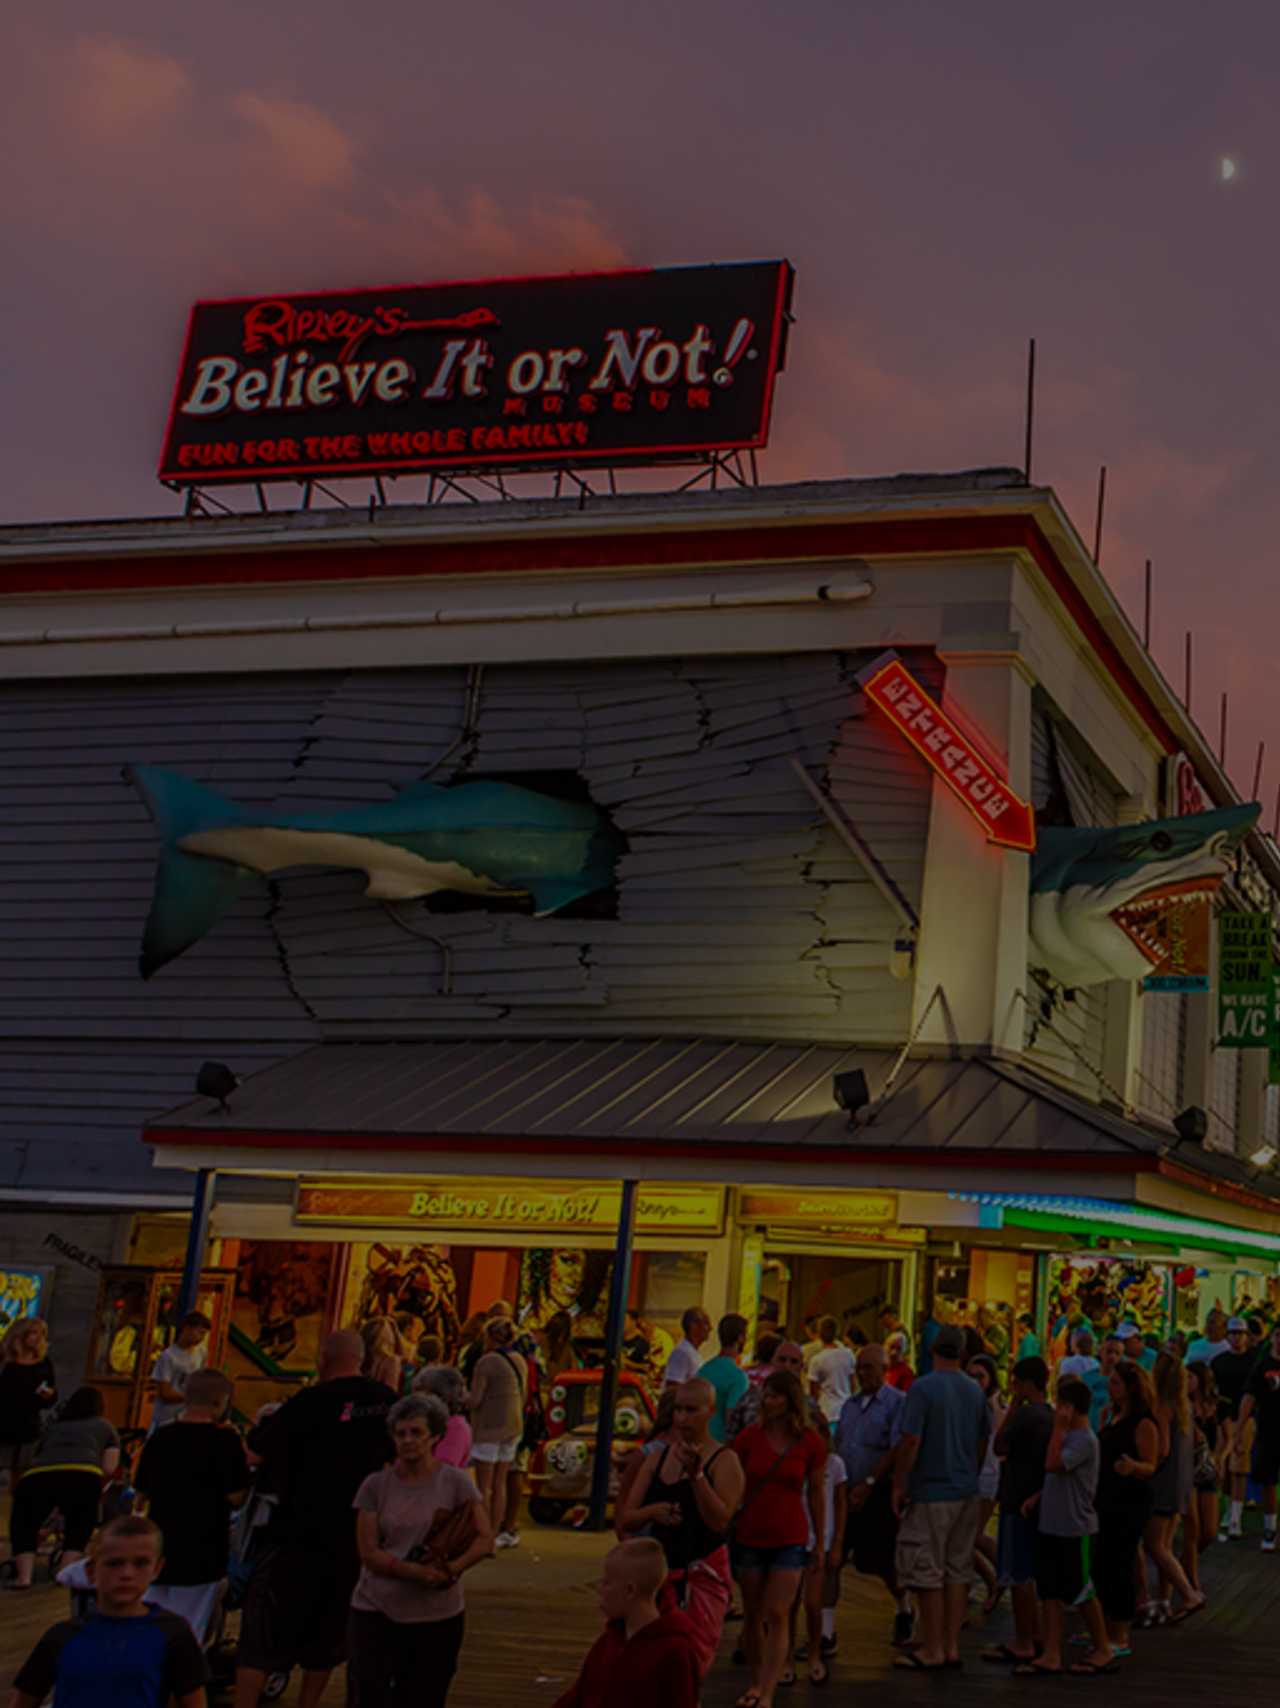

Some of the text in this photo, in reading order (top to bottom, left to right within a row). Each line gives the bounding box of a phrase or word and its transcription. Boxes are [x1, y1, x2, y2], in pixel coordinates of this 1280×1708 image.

[181, 316, 758, 417] Believe It or Not!
[177, 441, 239, 468] FUN
[242, 437, 299, 464] FOR
[301, 432, 361, 460] THE
[367, 427, 468, 457] WHOLE
[881, 676, 1011, 822] ENTRANCE
[1223, 962, 1267, 982] SUN.
[1222, 1008, 1268, 1038] A/C
[407, 1192, 489, 1219] Believe
[493, 1194, 518, 1219] It
[519, 1199, 540, 1220] or
